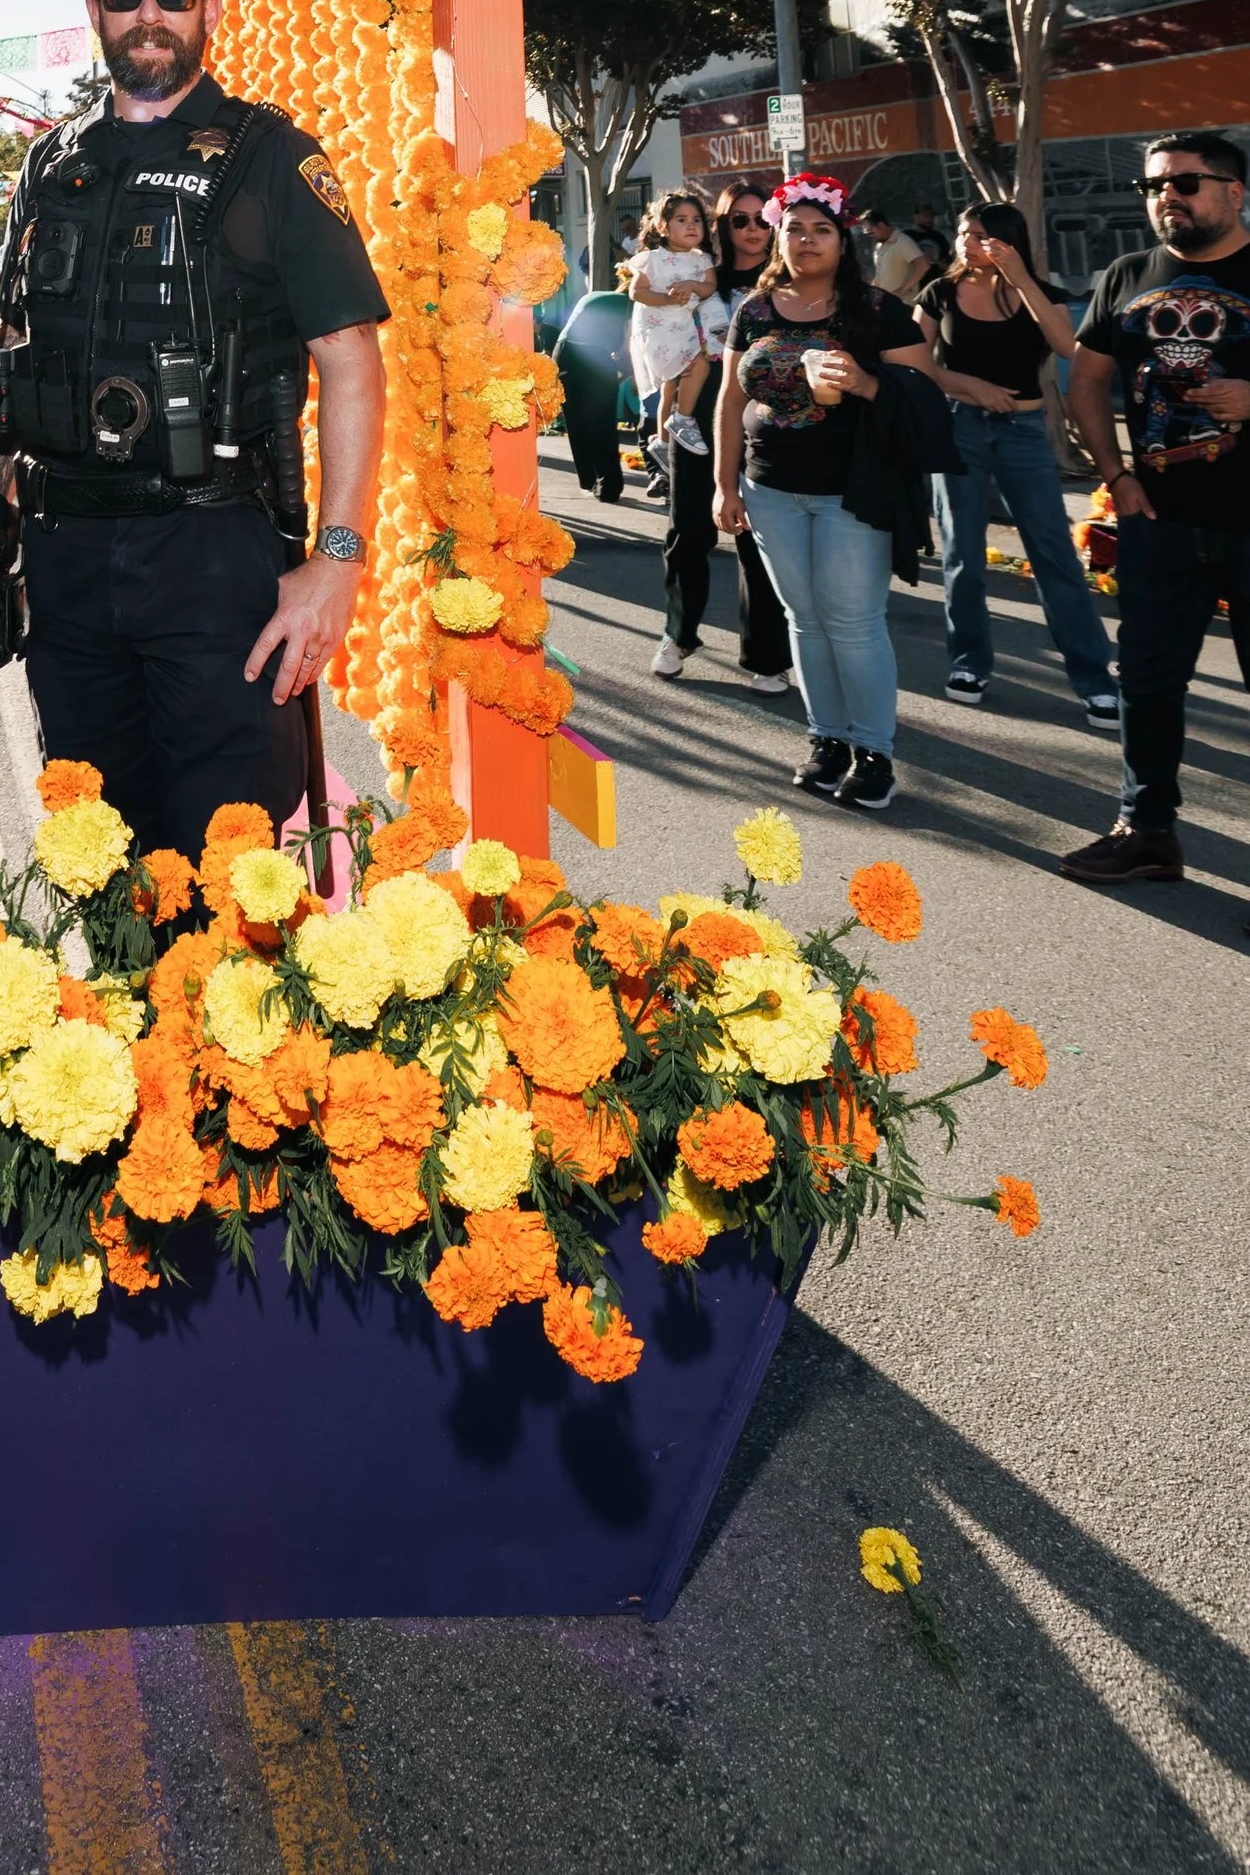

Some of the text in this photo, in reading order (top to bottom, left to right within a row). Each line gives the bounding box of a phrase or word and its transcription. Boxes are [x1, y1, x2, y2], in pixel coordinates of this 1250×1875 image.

[770, 98, 801, 112] 2 HOUR
[770, 114, 803, 125] PARKING
[807, 112, 888, 157] PACIFIC
[135, 172, 210, 197] POLICE
